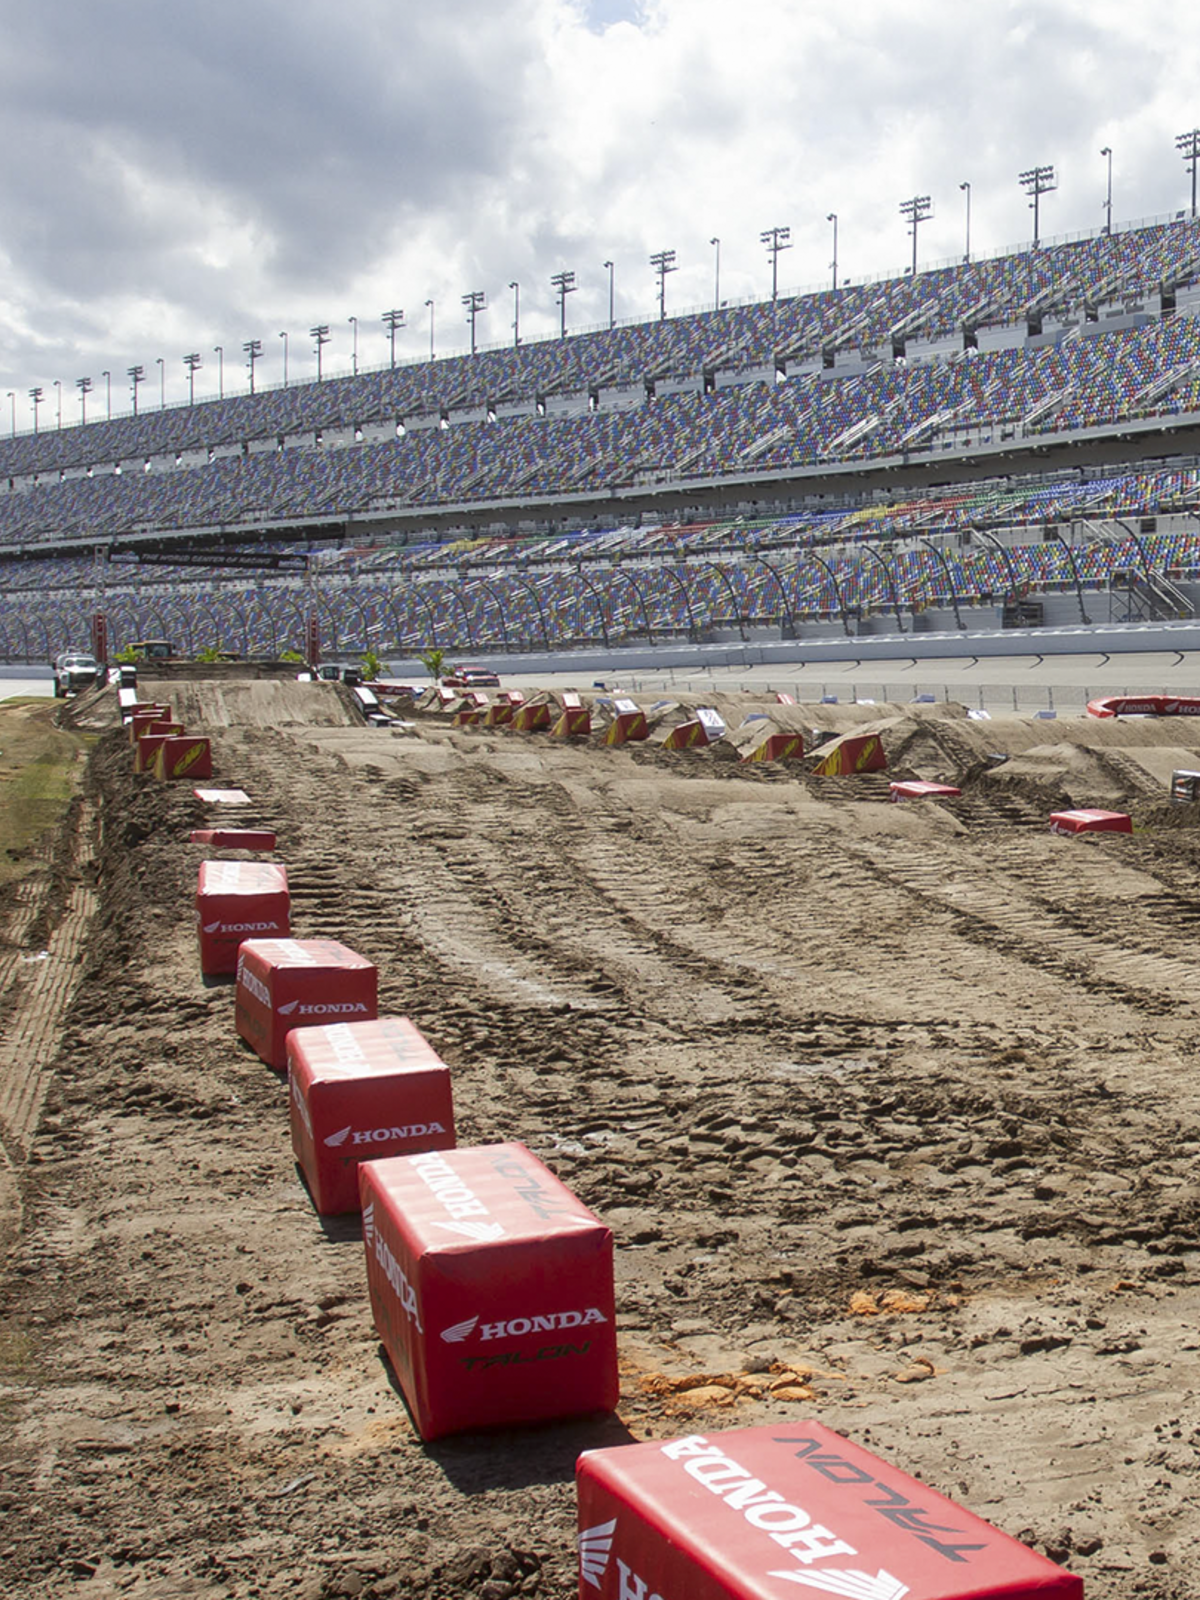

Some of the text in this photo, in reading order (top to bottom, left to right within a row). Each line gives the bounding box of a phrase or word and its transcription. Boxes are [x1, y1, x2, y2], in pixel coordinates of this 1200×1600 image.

[141, 553, 159, 561] THE
[1124, 703, 1157, 712] HONDA
[220, 921, 279, 933] HONDA
[298, 1003, 369, 1014] HONDA
[352, 1121, 446, 1145] HONDA
[408, 1151, 491, 1220] HONDA
[479, 1307, 608, 1341] HONDA
[460, 1341, 593, 1371] TALON
[660, 1434, 859, 1565] HONDA
[772, 1437, 991, 1564] TALON
